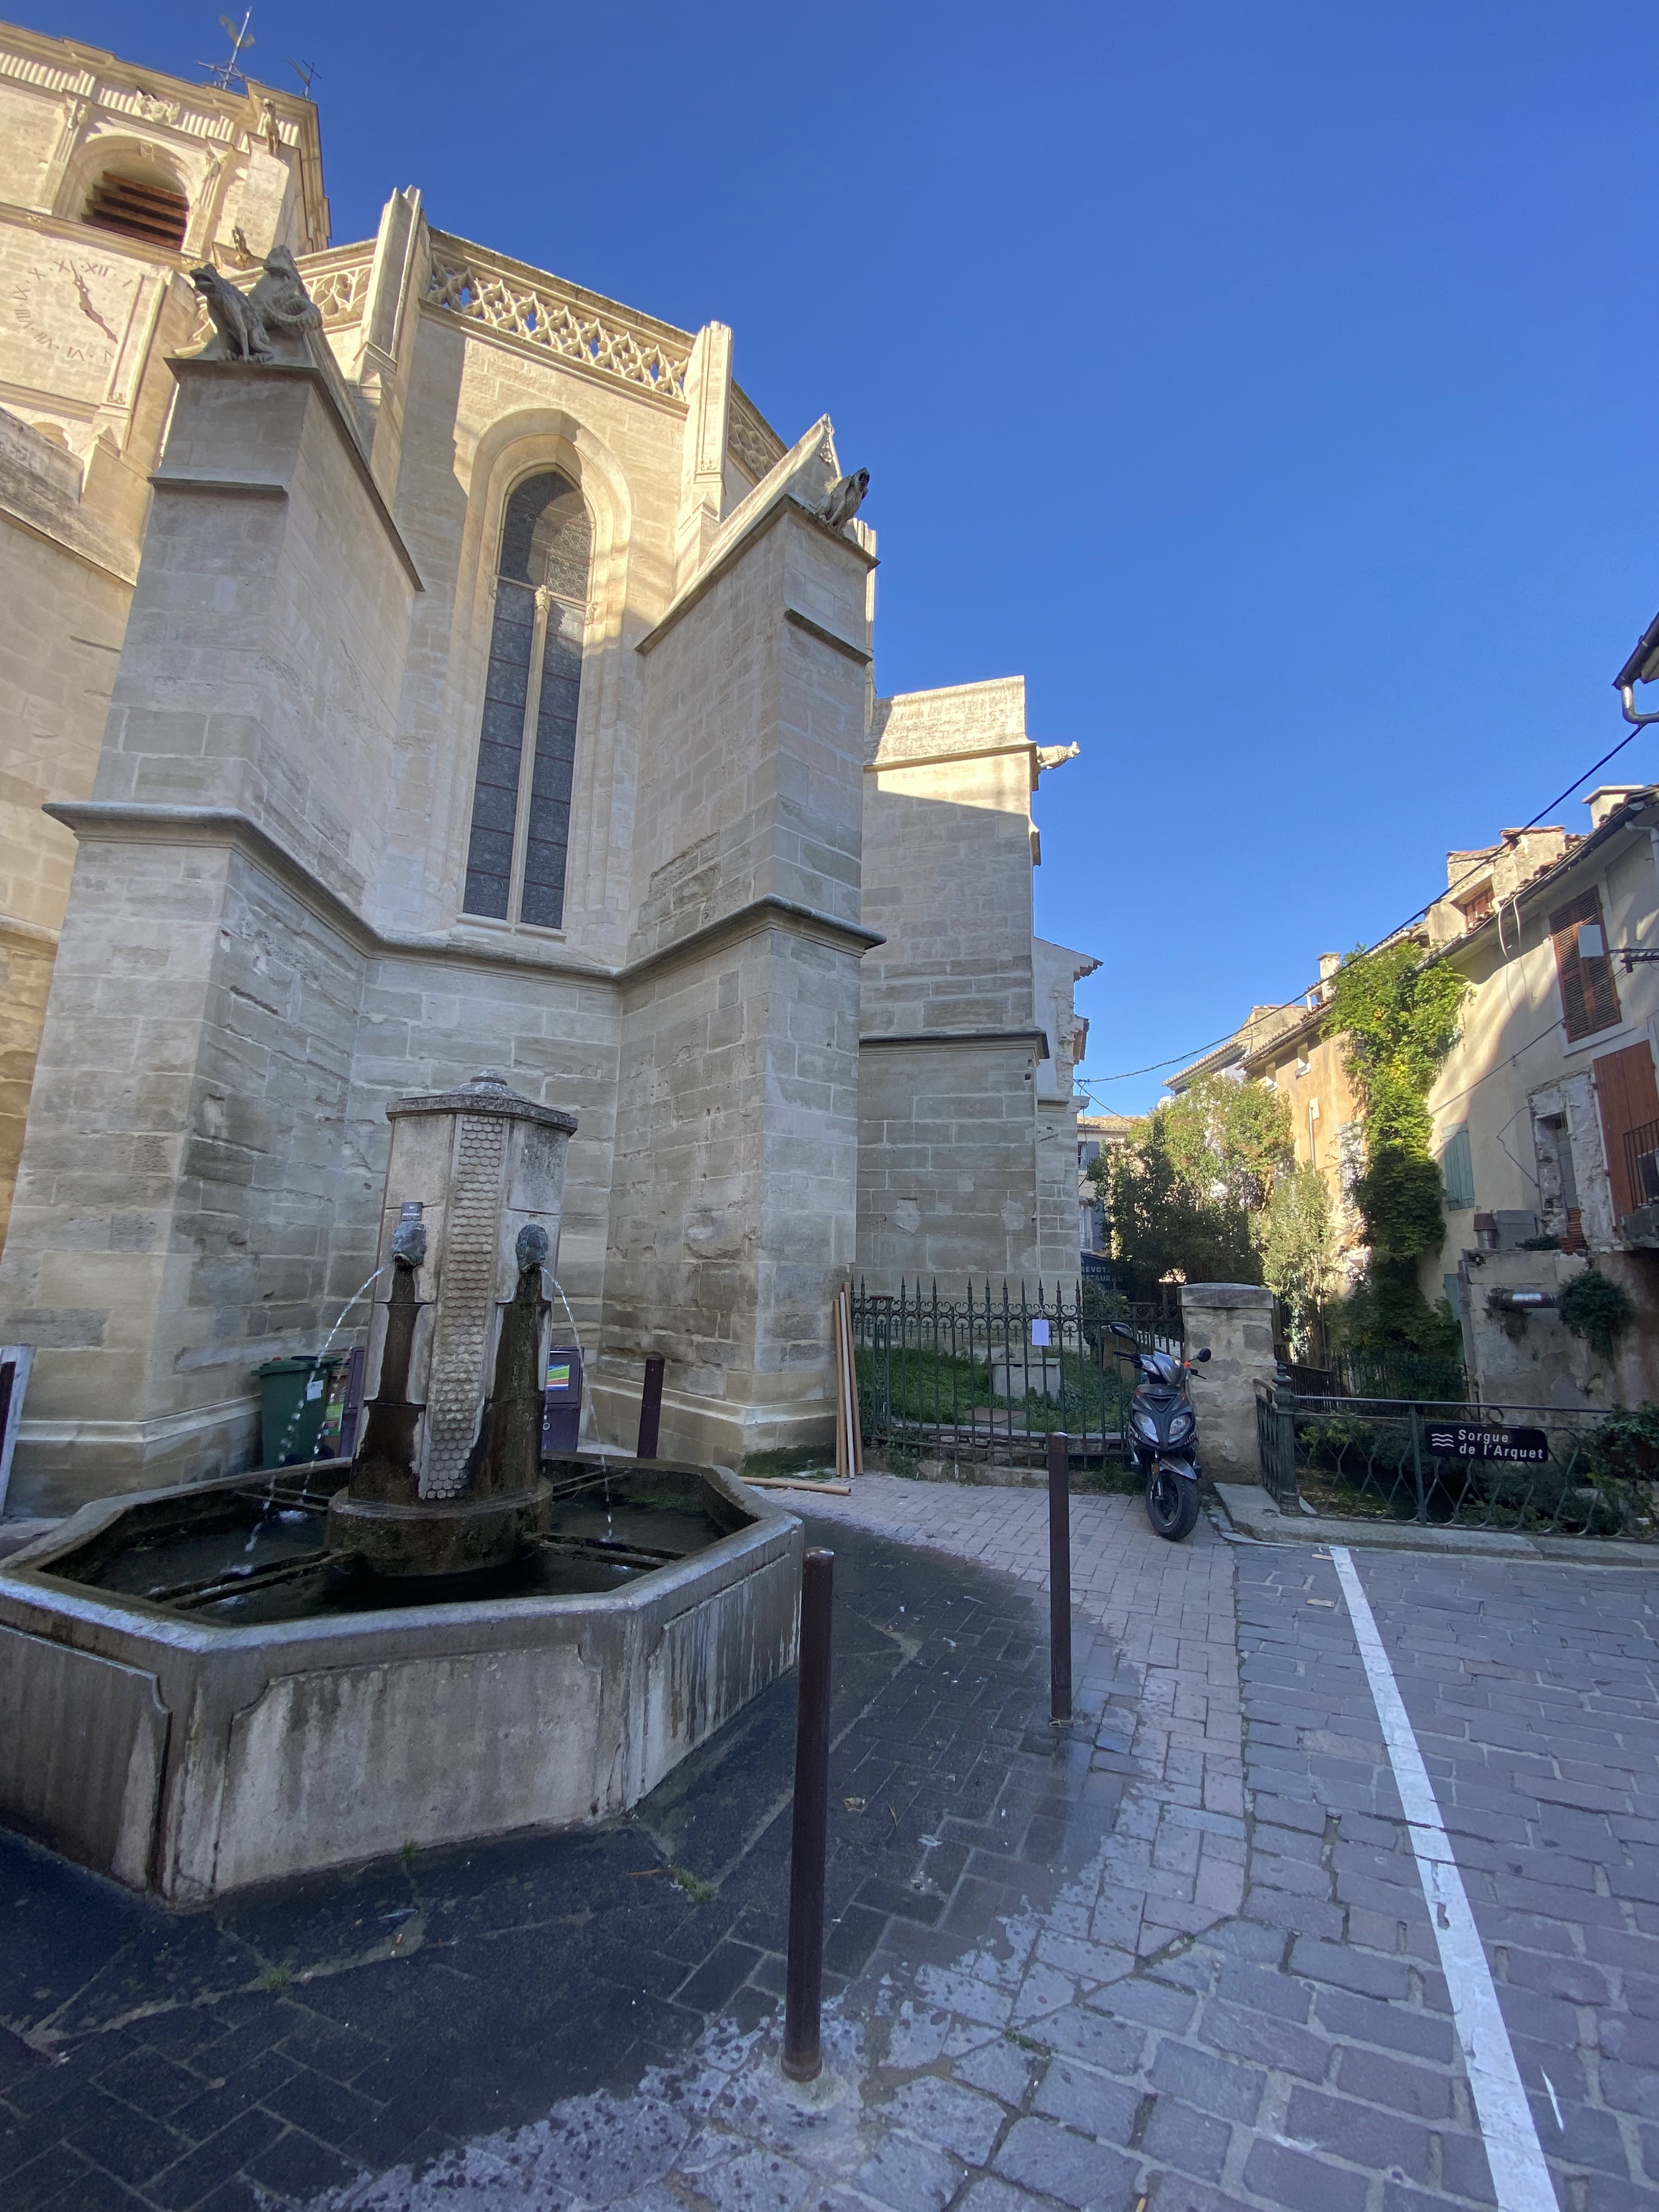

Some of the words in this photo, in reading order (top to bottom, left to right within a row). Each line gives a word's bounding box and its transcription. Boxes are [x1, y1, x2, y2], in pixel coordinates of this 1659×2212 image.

[28, 268, 47, 281] X
[84, 262, 109, 276] XII
[1458, 1429, 1509, 1444] Sorgue
[1459, 1443, 1476, 1454] de
[1483, 1444, 1543, 1460] l'Arquet
